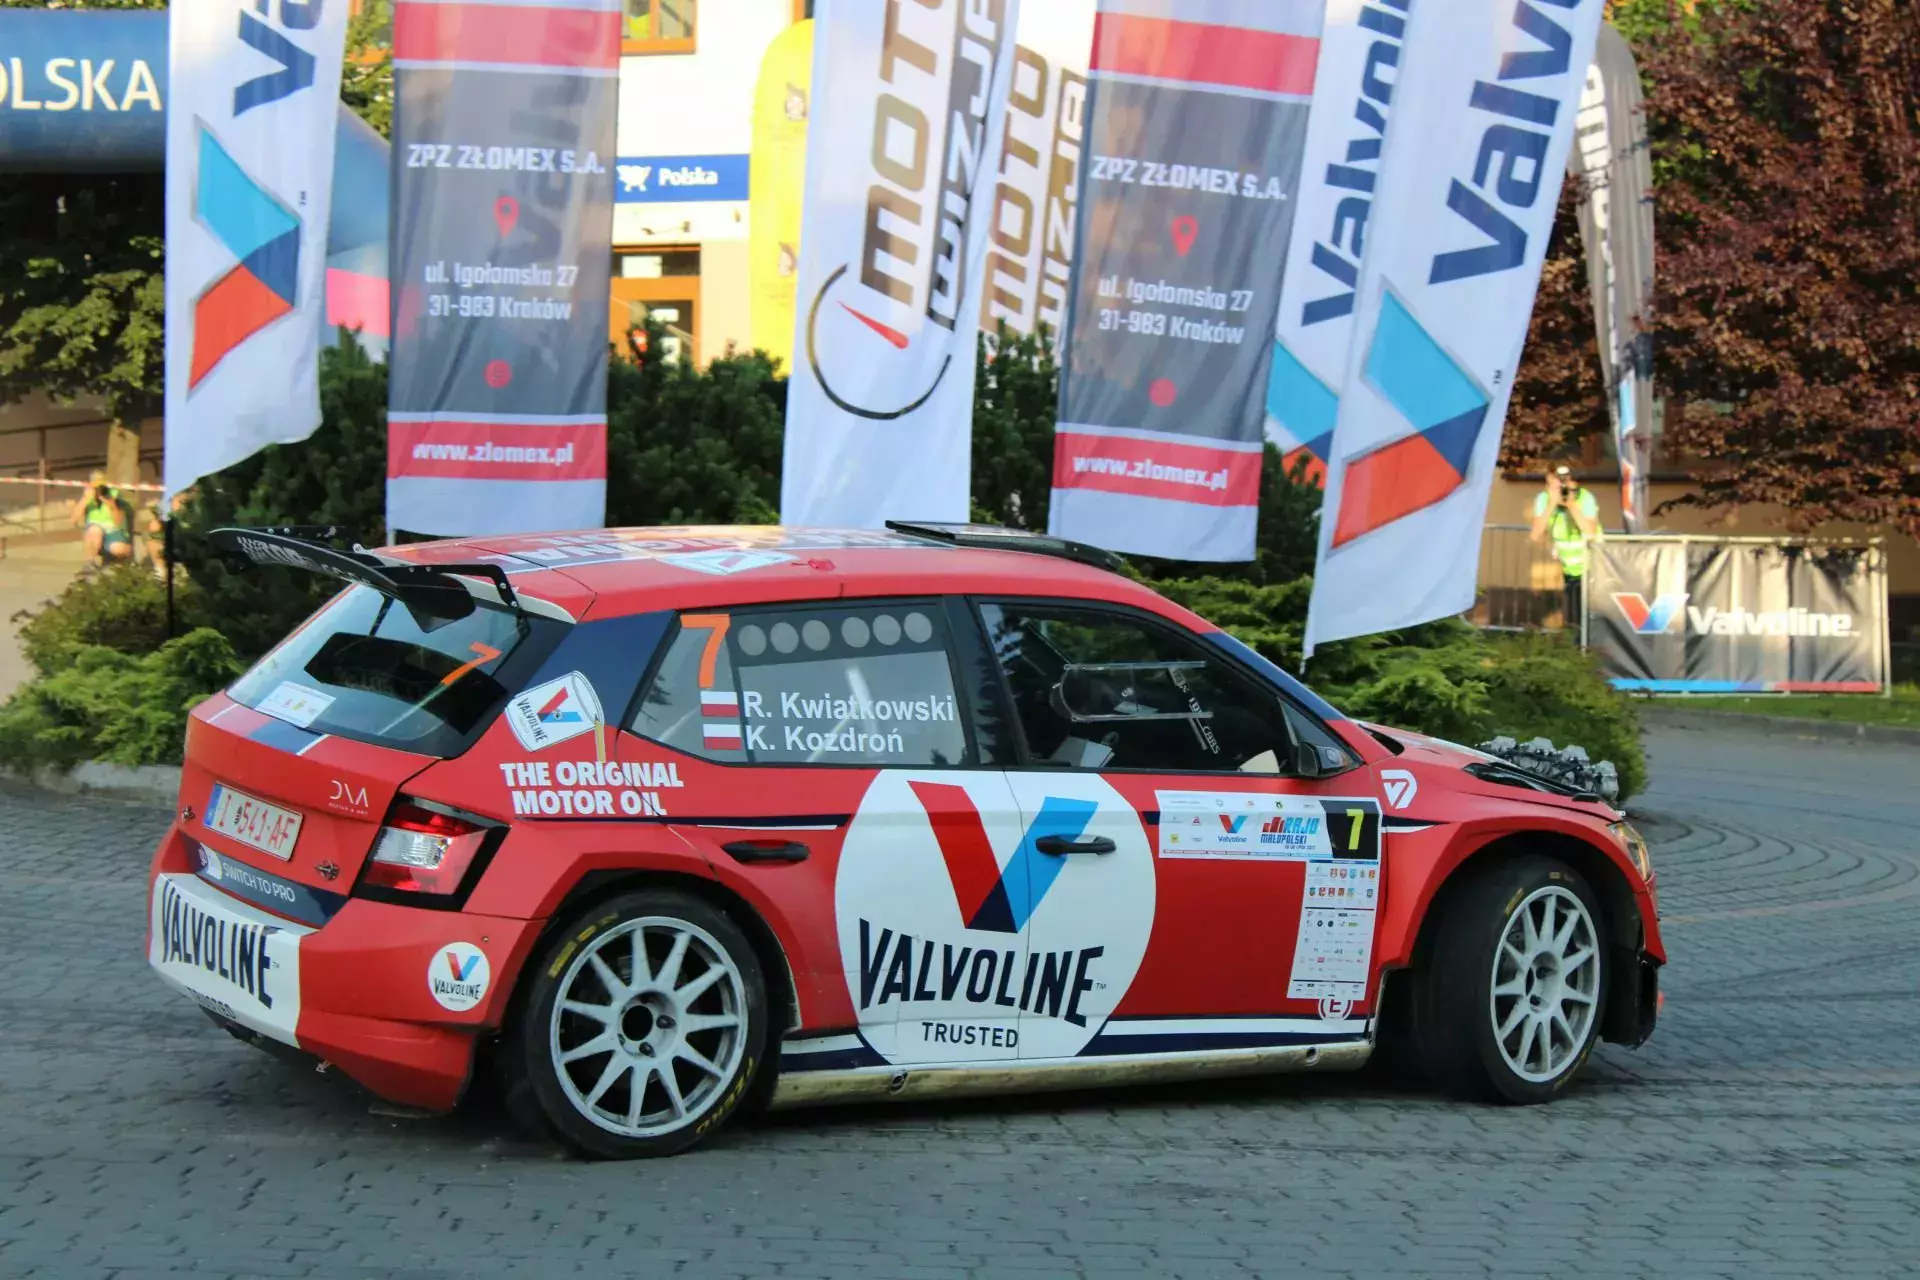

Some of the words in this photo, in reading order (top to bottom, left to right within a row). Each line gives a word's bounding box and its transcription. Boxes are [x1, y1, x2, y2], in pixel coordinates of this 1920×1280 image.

[0, 57, 163, 112] LSKA
[407, 144, 452, 168] ZPZ
[457, 145, 556, 172] ZŁOMEX
[559, 149, 606, 174] S.A.
[860, 0, 944, 307] MOT
[1427, 0, 1580, 286] Valv
[658, 167, 719, 186] Polska
[1090, 156, 1138, 183] ZPZ
[1141, 162, 1240, 196] ZŁOMEX
[1242, 174, 1288, 201] S.A.
[425, 261, 449, 283] ul.
[556, 265, 580, 287] 27
[429, 295, 495, 317] 31-983
[499, 296, 572, 320] Kraków
[1097, 275, 1122, 298] ul.
[1230, 290, 1254, 312] 27
[1099, 309, 1166, 336] 31-983
[1169, 315, 1245, 344] Kraków
[1687, 605, 1854, 637] Valvoline
[680, 614, 730, 688] 7
[516, 697, 549, 743] VALVOLINE
[743, 691, 772, 718] R.
[780, 691, 954, 721] Kwiatkowski
[746, 725, 775, 750] K.
[784, 725, 904, 753] Kozdroń
[499, 762, 552, 788] THE
[555, 761, 685, 788] ORIGINAL
[512, 790, 616, 816] MOTOR
[620, 790, 668, 816] OIL
[1345, 808, 1365, 850] 7
[222, 861, 257, 890] SWITCH
[257, 877, 272, 895] TO
[271, 882, 296, 903] PRO
[162, 878, 284, 1010] VALVOLINE
[434, 977, 481, 1000] VALVOLINE
[859, 917, 1104, 1028] VALVOLINE
[922, 1022, 1019, 1048] TRUSTED
